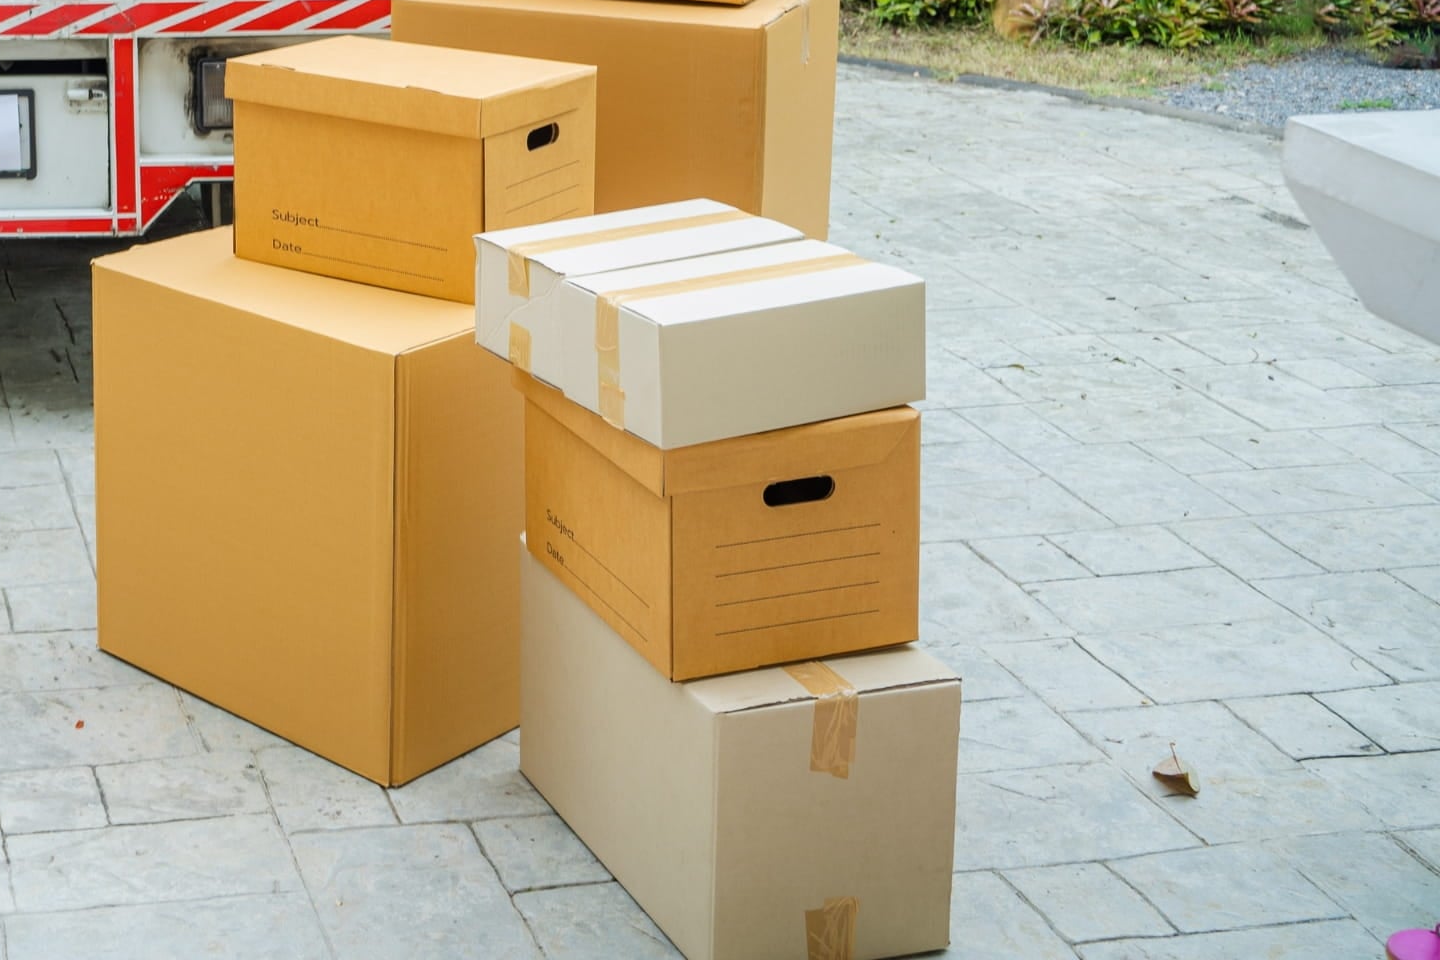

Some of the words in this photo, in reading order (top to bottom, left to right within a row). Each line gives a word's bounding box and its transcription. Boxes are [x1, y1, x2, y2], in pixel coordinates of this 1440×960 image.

[272, 209, 320, 227] Subject
[272, 239, 302, 254] Date
[546, 508, 575, 541] Subject
[546, 542, 565, 566] Date
